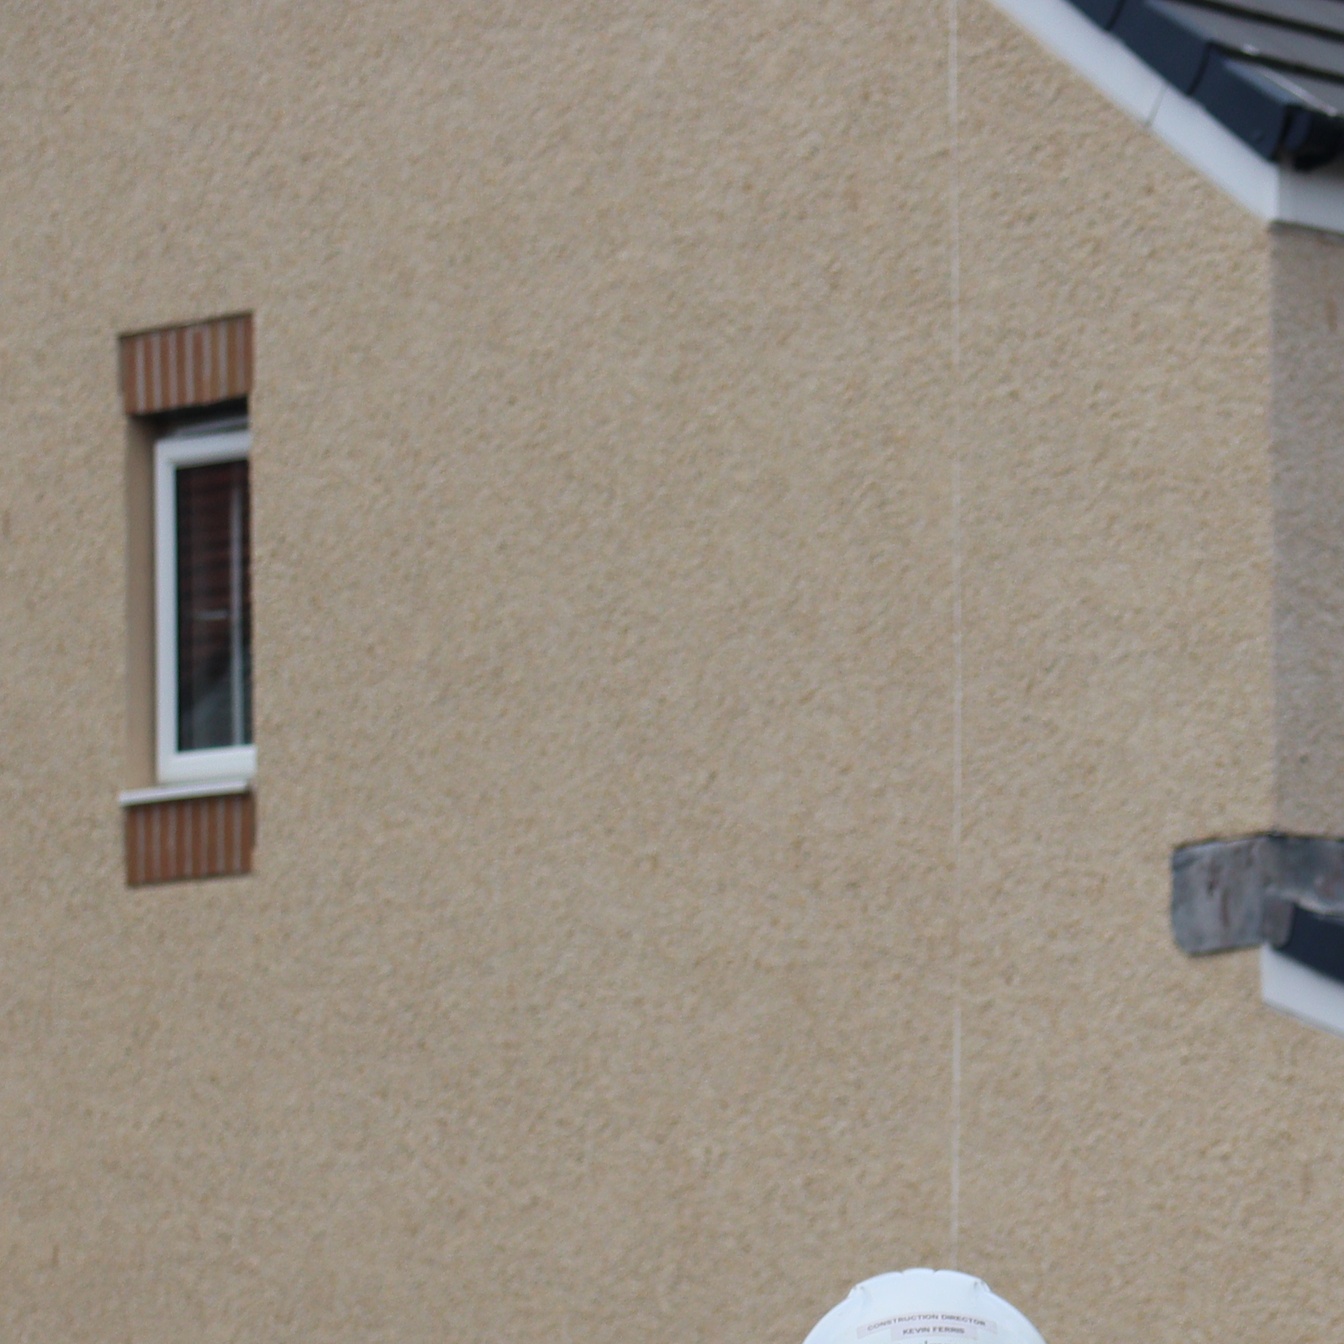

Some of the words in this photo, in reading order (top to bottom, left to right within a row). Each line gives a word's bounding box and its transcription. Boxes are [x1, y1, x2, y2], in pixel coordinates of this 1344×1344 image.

[867, 1314, 938, 1330] CONSTRUCTION
[941, 1313, 986, 1326] DIRECTOR
[902, 1327, 930, 1335] KEVIN
